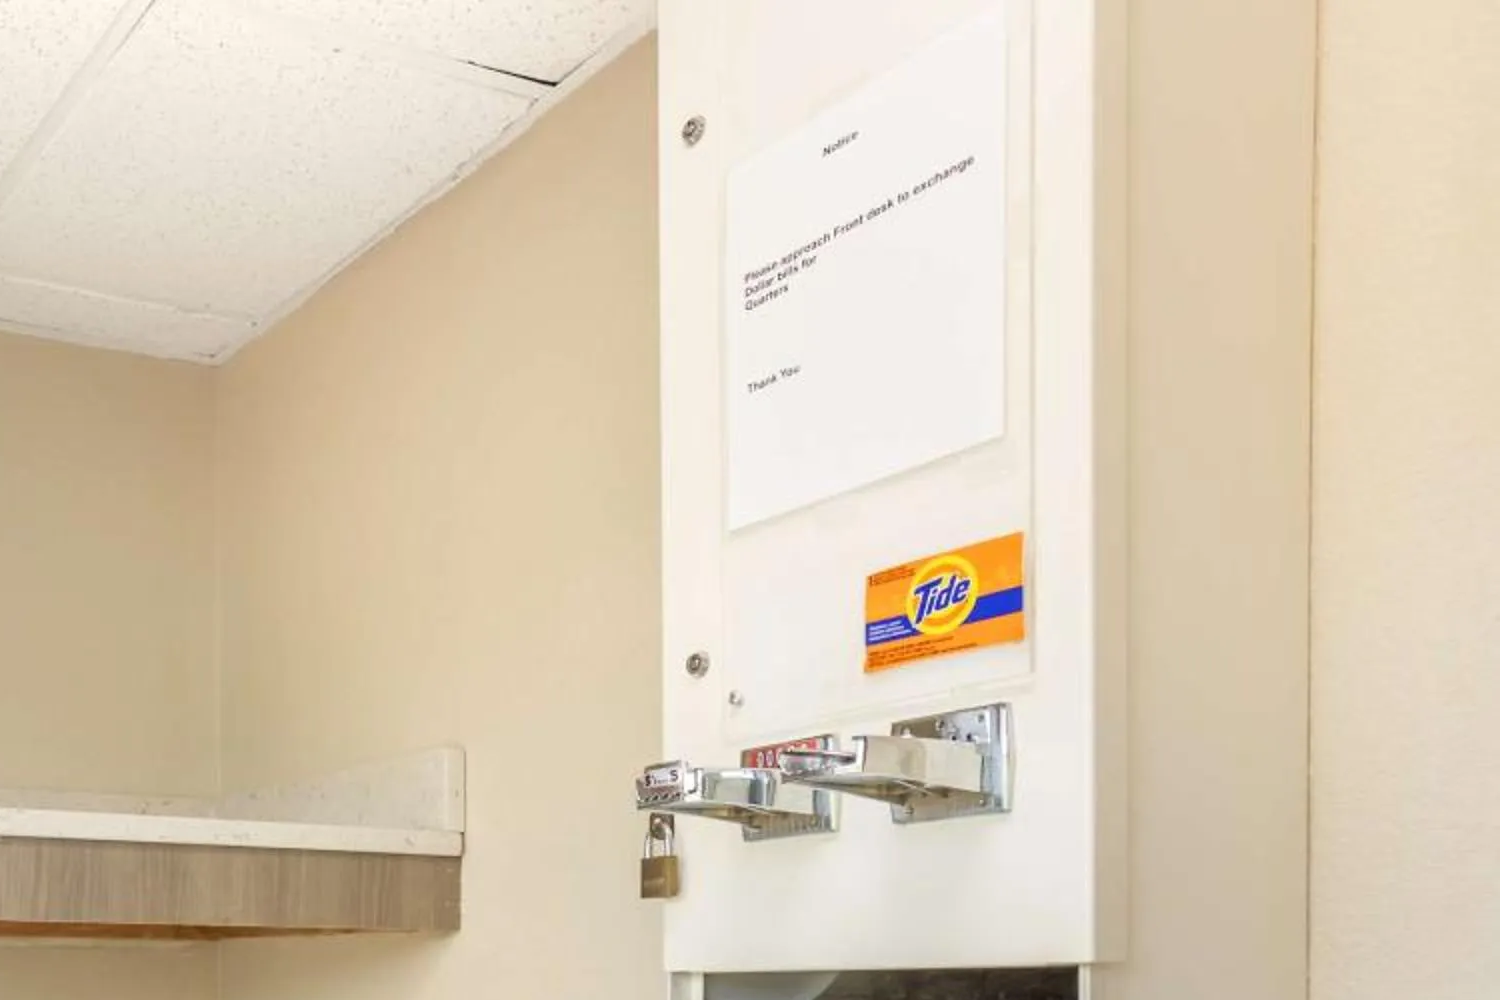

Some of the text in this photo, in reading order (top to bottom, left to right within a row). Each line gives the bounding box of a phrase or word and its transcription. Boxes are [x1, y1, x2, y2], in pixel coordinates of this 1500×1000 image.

[821, 130, 860, 157] Notice
[743, 154, 975, 284] Please approach Front desk to exchange
[743, 255, 818, 298] Dollar bills for
[743, 284, 790, 311] Quarters
[747, 364, 802, 394] Thank You
[913, 574, 972, 625] Tide
